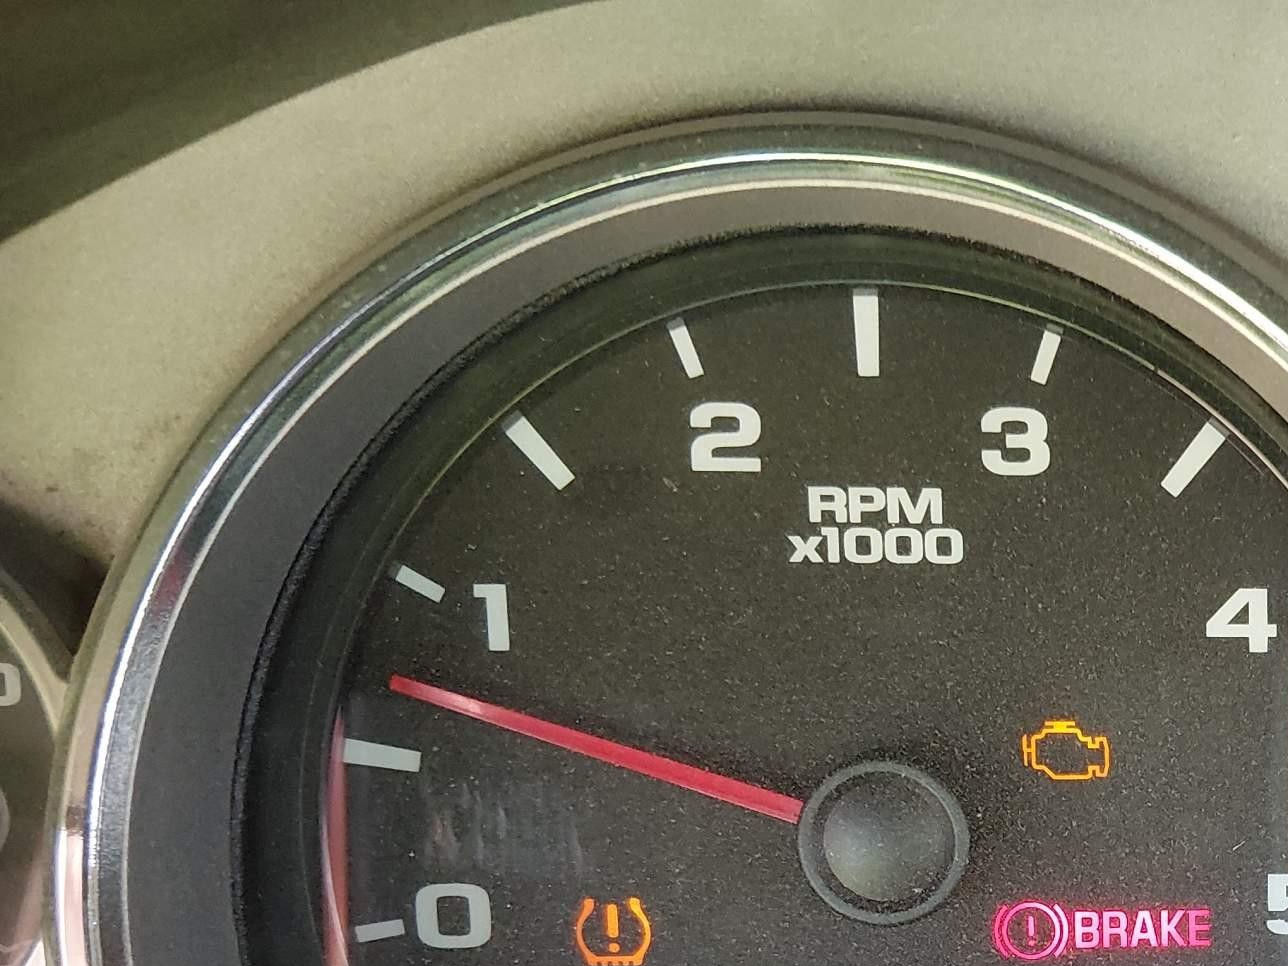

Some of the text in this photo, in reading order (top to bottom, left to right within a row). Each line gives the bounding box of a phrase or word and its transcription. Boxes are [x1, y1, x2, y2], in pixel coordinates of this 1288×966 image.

[689, 401, 762, 473] 2
[980, 406, 1051, 476] 3
[807, 486, 943, 525] RPM
[788, 527, 964, 565] x1000
[472, 583, 511, 652] 1
[1206, 588, 1278, 653] 4
[414, 882, 493, 950] 0
[1074, 909, 1212, 949] BRAKE
